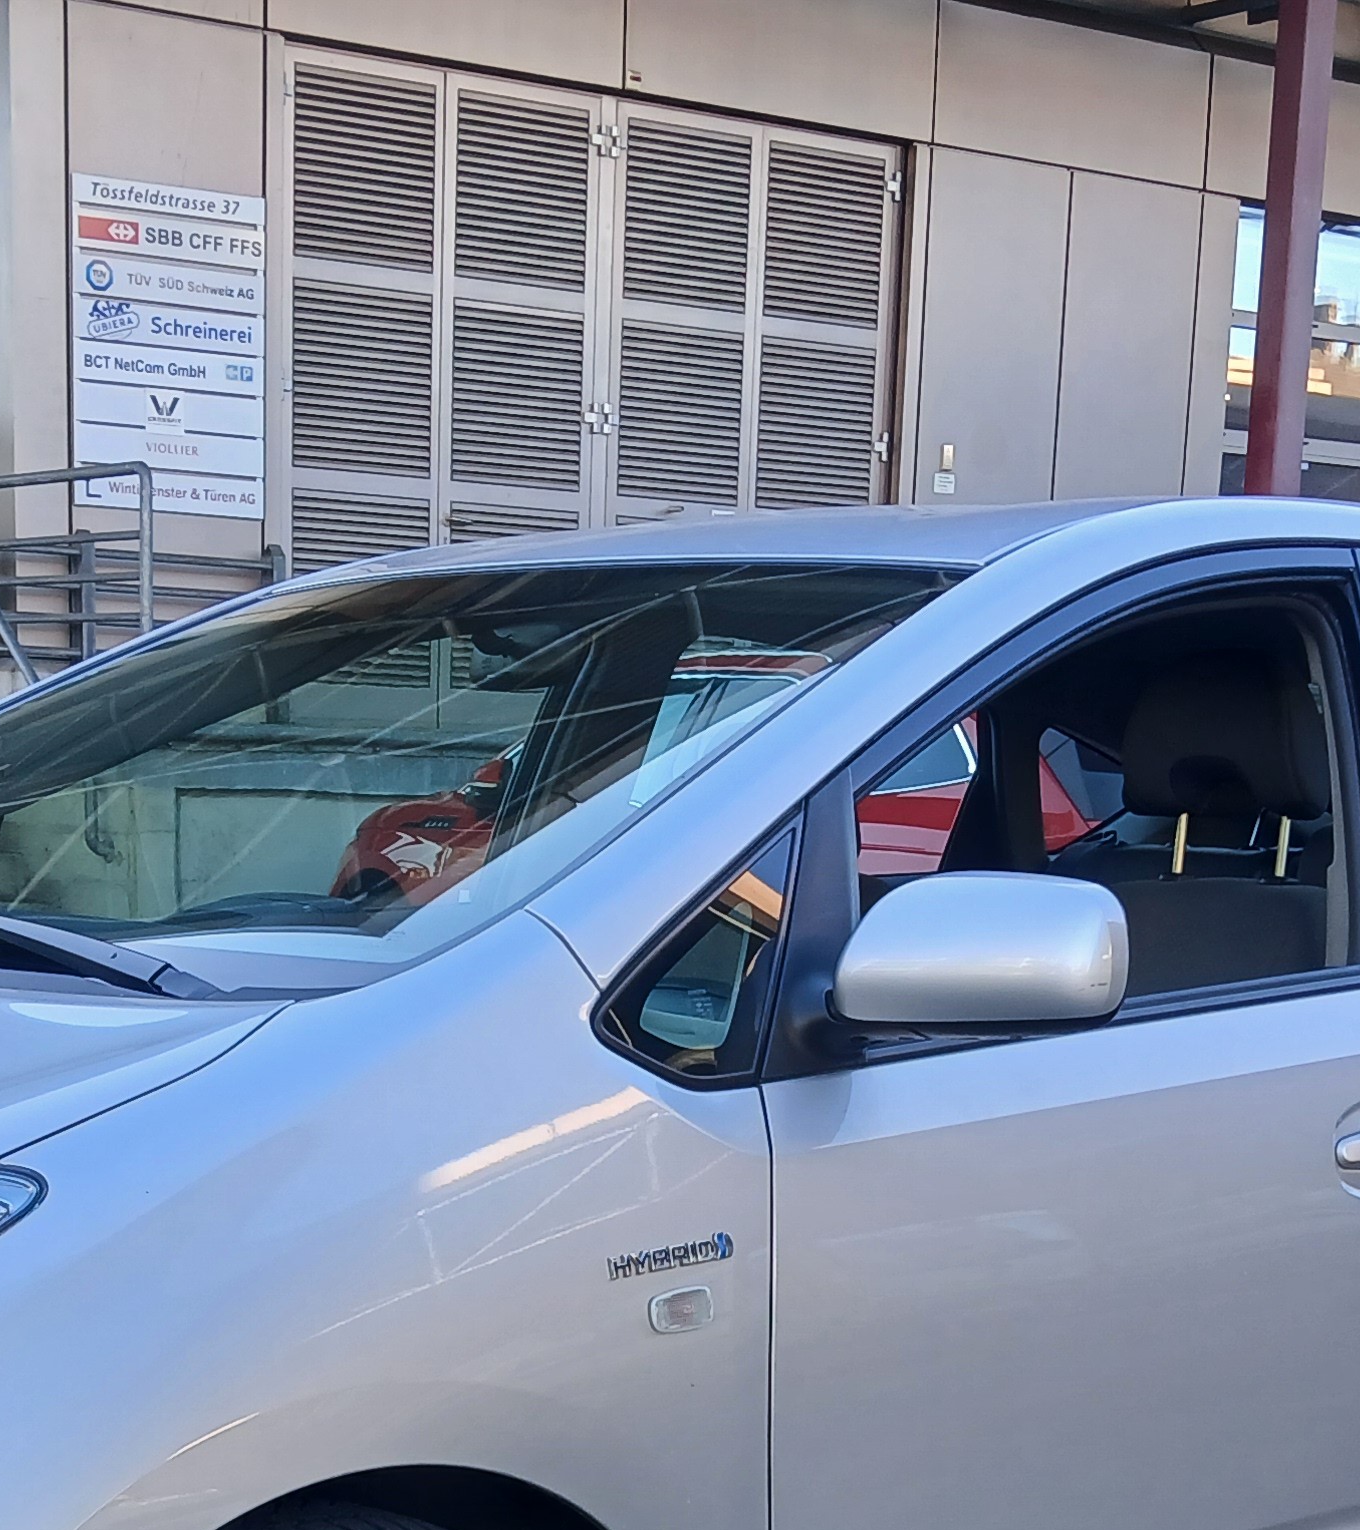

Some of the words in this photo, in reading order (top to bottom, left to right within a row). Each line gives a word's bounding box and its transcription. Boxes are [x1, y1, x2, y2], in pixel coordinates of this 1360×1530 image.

[91, 182, 216, 213] Tössfeldstrasse
[221, 200, 240, 215] 37
[145, 226, 183, 247] SBB
[189, 233, 224, 252] CFF
[229, 238, 262, 258] FFS
[127, 272, 151, 286] TÜV
[158, 277, 184, 291] SÜD
[187, 281, 234, 298] Schweiz
[237, 287, 255, 300] AG
[93, 316, 134, 334] UBIERA
[151, 316, 252, 344] Schreinerei
[84, 354, 111, 369] BCT
[167, 362, 206, 379] GmbH
[145, 442, 199, 456] VIOLLIER
[149, 486, 187, 499] enster
[190, 487, 200, 500] &
[203, 489, 236, 504] Türen
[239, 493, 256, 504] AG
[606, 1240, 716, 1281] HYBRID
